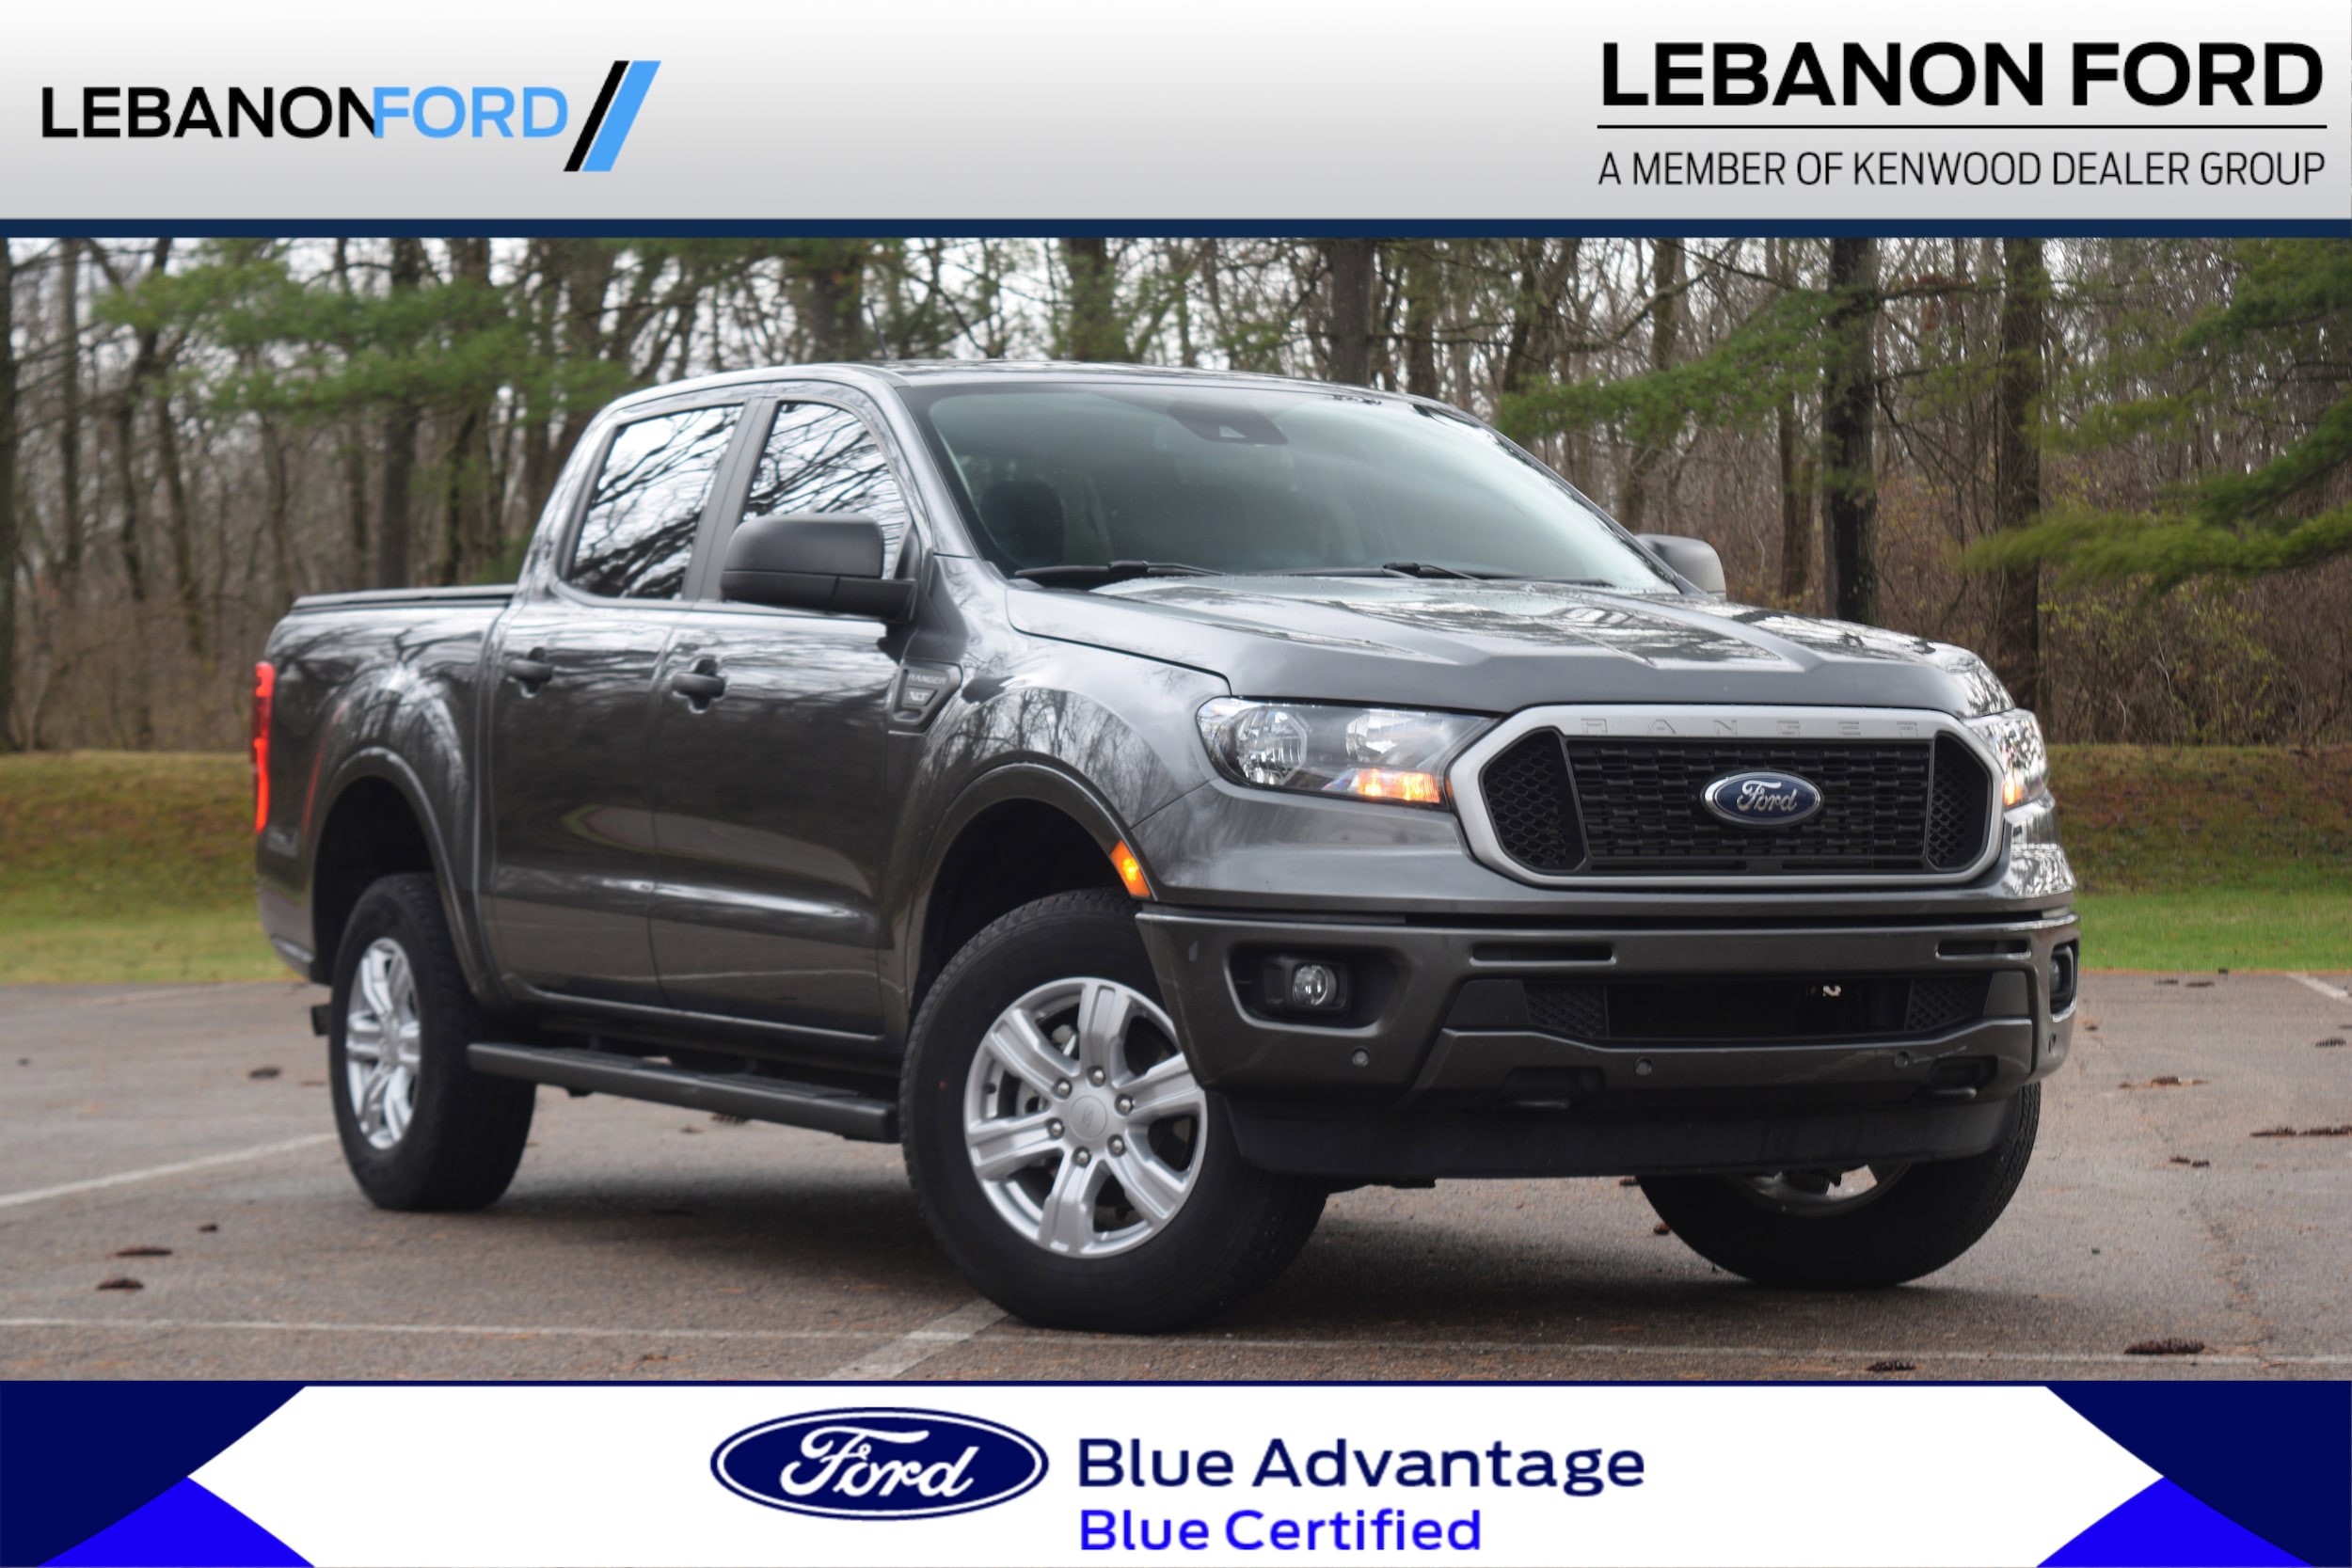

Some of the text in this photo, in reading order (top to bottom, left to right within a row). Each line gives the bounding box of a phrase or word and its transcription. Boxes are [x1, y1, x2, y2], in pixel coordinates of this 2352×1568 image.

[908, 673, 946, 685] RANGER
[1581, 718, 1918, 736] RANGER
[1737, 780, 1798, 812] Ford
